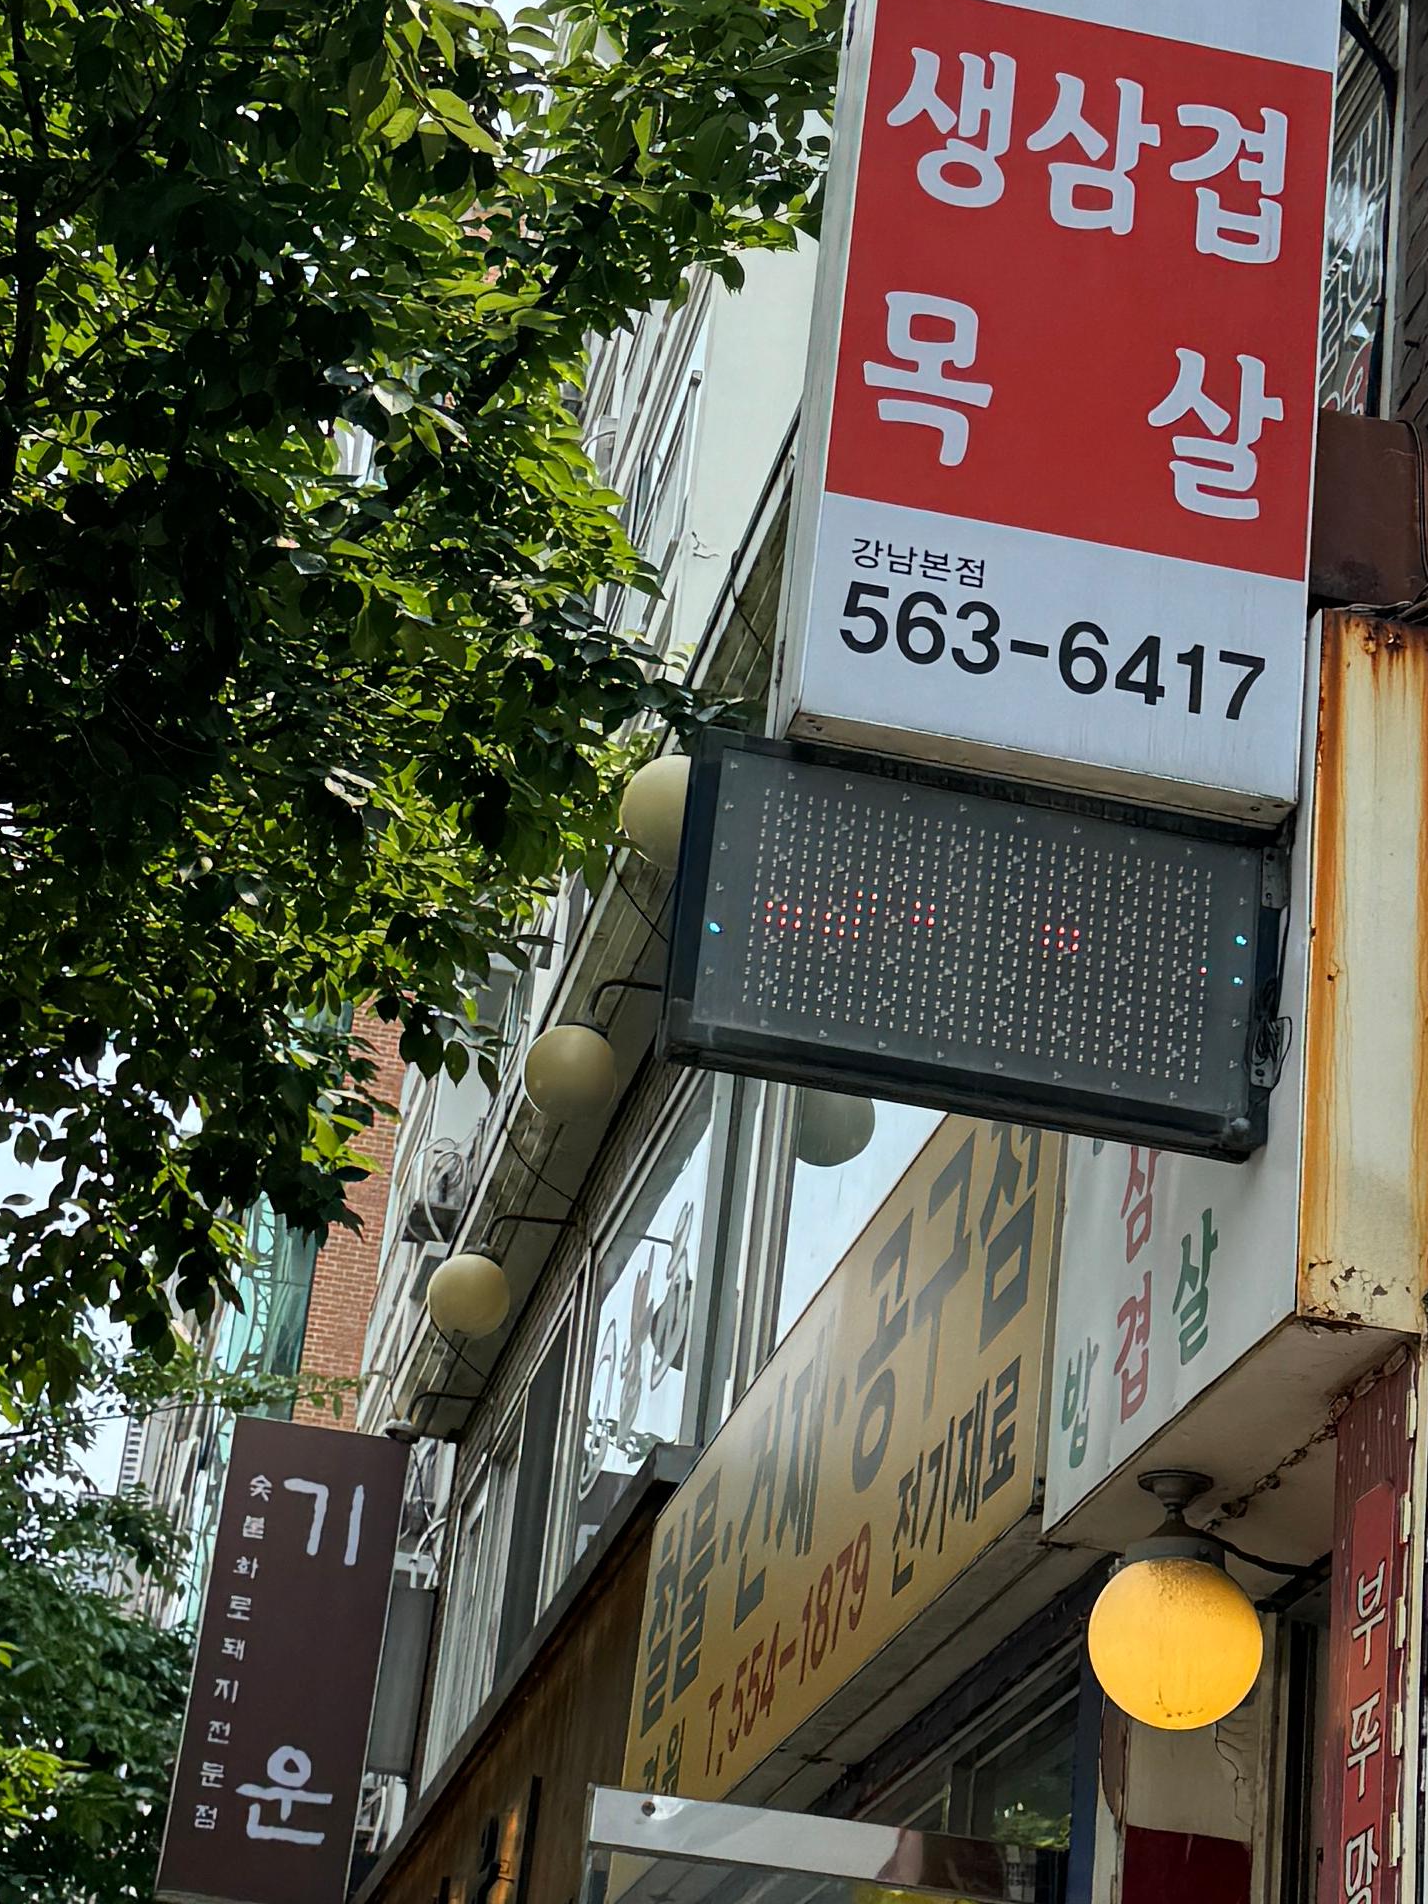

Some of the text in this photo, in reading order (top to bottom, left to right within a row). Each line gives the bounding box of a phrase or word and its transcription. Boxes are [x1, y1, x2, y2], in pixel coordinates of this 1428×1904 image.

[886, 47, 1289, 264] 생삼겹
[839, 582, 1266, 721] 563-6417
[852, 538, 986, 589] 강남본점
[891, 1354, 1021, 1597] 전기재료
[236, 1478, 365, 1845] 기운
